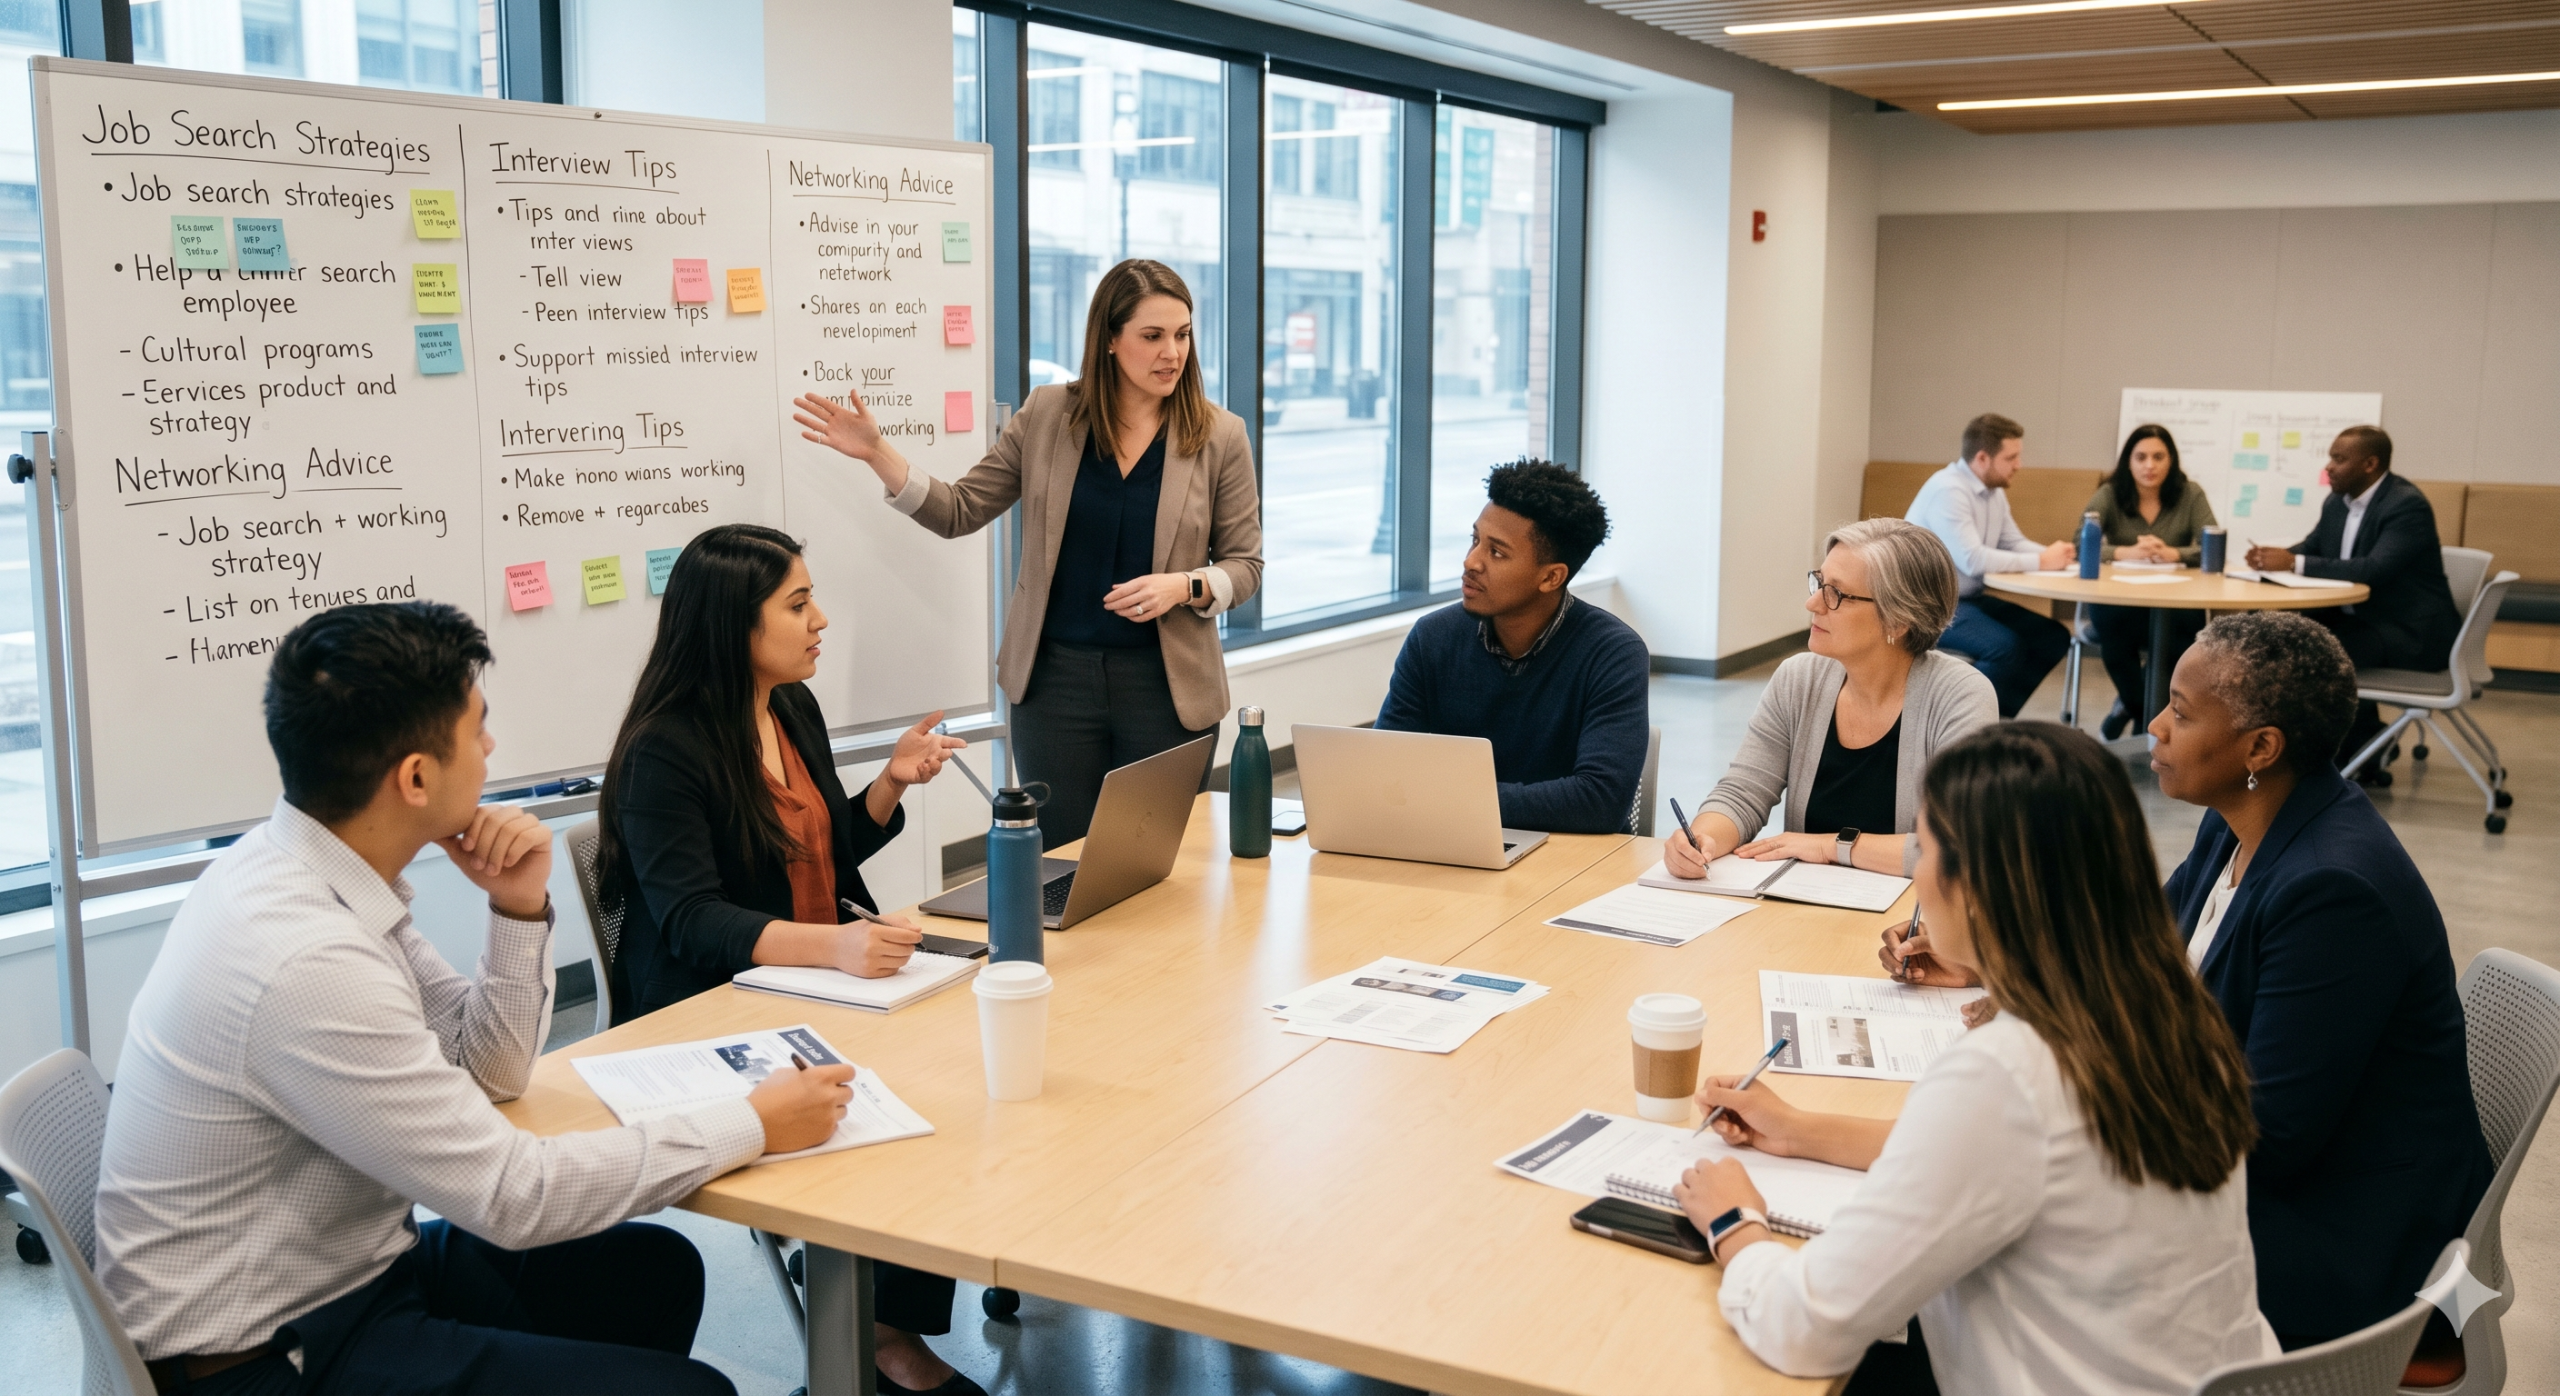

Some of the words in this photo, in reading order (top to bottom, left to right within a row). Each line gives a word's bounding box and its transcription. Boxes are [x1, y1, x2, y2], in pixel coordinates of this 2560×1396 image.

[81, 103, 151, 146] Job
[170, 109, 277, 150] Search
[295, 120, 431, 175] Strategies
[489, 142, 611, 175] Interview
[625, 150, 677, 187] Tips
[120, 172, 172, 203] Job
[187, 179, 270, 206] search
[285, 182, 395, 219] strategies
[789, 160, 888, 203] Networking
[900, 167, 953, 195] Advice
[509, 198, 554, 227] Tips
[564, 204, 600, 223] and
[656, 206, 707, 225] about
[809, 211, 859, 235] Advise
[866, 222, 880, 235] in
[888, 223, 919, 243] your
[582, 233, 634, 252] views
[896, 243, 922, 259] and
[134, 253, 192, 290] Help
[321, 261, 397, 284] search
[531, 265, 568, 288] Tell
[580, 268, 622, 287] view
[819, 264, 893, 282] netetwork
[183, 289, 298, 323] employee
[535, 302, 578, 322] Peen
[588, 303, 667, 321] interview
[674, 301, 709, 327] tips
[810, 294, 861, 315] Shares
[869, 302, 886, 314] an
[895, 298, 927, 315] each
[141, 334, 247, 364] Cultural
[264, 342, 374, 369] programs
[513, 343, 595, 374] Support
[606, 345, 670, 365] missied
[680, 345, 758, 363] interview
[525, 375, 568, 405] tips
[814, 360, 853, 382] Back
[862, 367, 896, 388] your
[258, 375, 347, 409] product
[357, 373, 398, 396] and
[150, 409, 251, 441] strategy
[501, 419, 625, 454] Intervering
[636, 412, 685, 446] Tips
[115, 454, 287, 500] Networking
[305, 446, 394, 479] Advice
[515, 467, 565, 489] Make
[681, 459, 745, 487] working
[178, 515, 230, 547] Job
[243, 511, 323, 540] search
[358, 503, 448, 539] working
[518, 504, 585, 528] Remove
[617, 496, 709, 526] regarcabes
[211, 547, 322, 581] strategy
[187, 593, 239, 623] List
[250, 597, 279, 615] on
[288, 586, 368, 611] tenues
[376, 576, 416, 601] and
